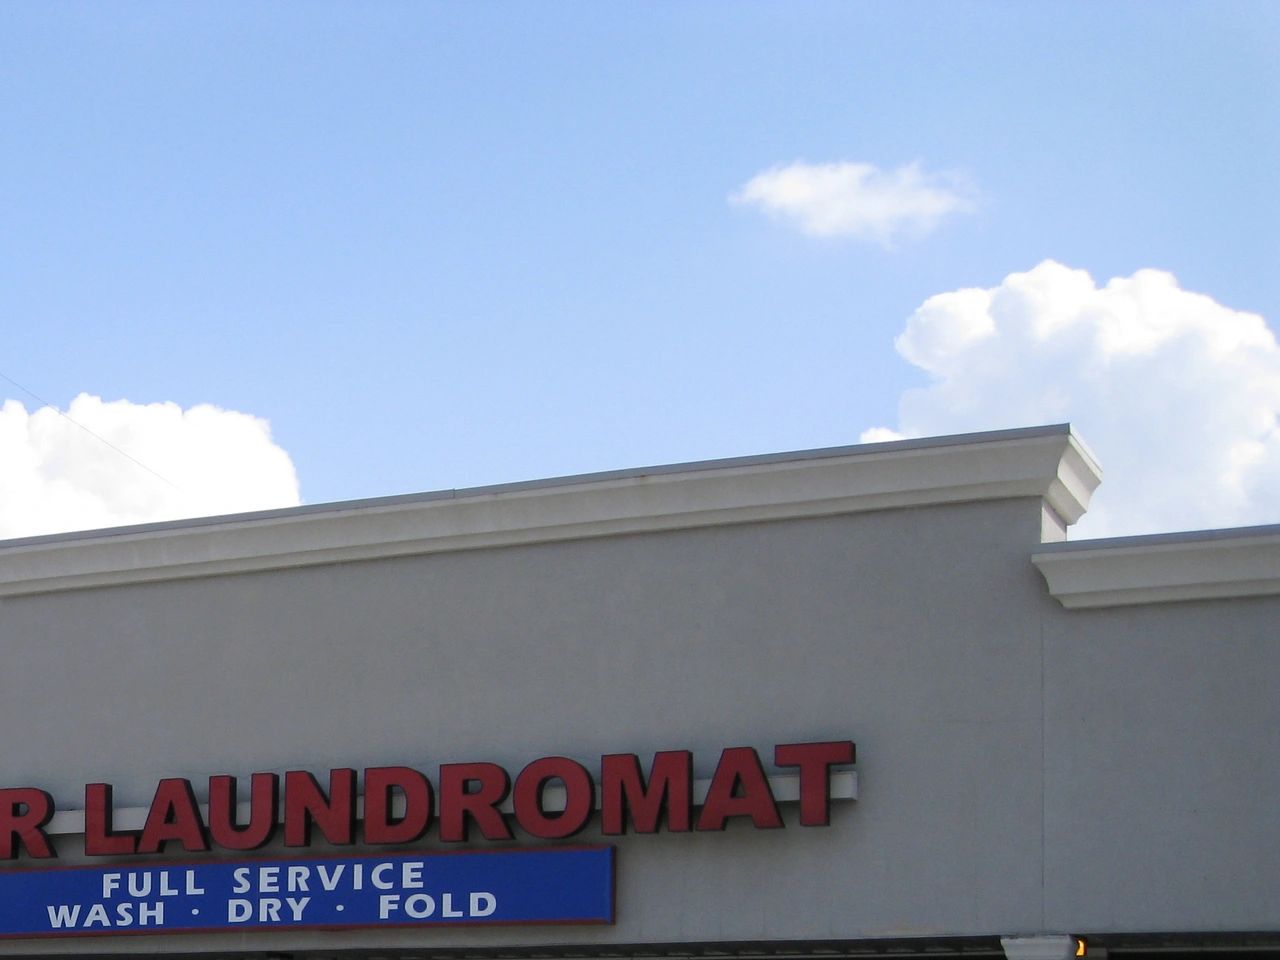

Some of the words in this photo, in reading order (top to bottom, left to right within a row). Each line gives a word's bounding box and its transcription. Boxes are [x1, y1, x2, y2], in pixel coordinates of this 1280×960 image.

[85, 741, 856, 856] LAUNDROMAT
[102, 869, 205, 899] FULL
[232, 862, 425, 894] SERVICE
[46, 901, 165, 928] WASH
[227, 897, 311, 923] DRY
[379, 892, 498, 919] FOLD
